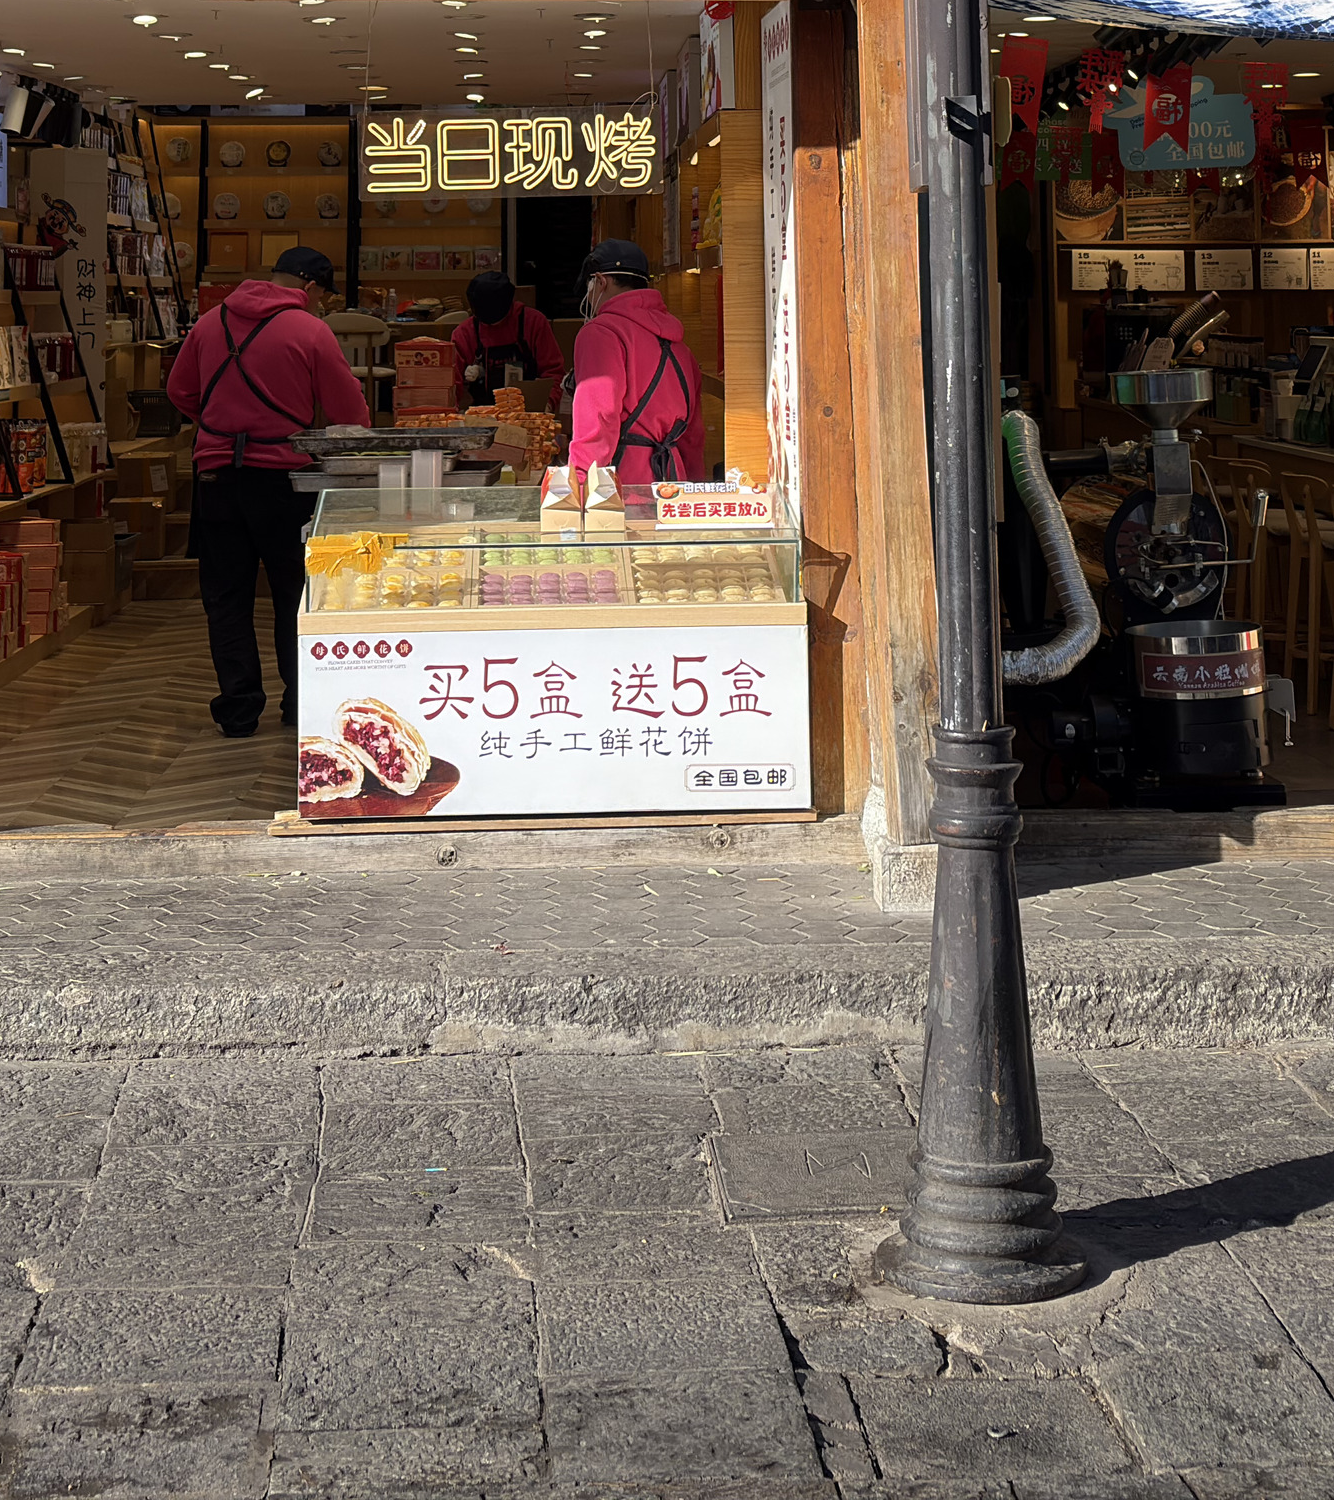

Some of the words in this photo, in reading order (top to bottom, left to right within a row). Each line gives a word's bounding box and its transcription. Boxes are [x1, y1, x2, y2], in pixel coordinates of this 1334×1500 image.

[364, 113, 657, 193] 当日现烤
[1166, 141, 1245, 162] 全国包邮
[76, 258, 96, 350] 财神上门
[661, 502, 768, 518] 先尝后买更放心
[314, 643, 410, 657] 母氏鲜花饼
[1152, 660, 1261, 682] 云南小粒咖啡
[418, 656, 583, 722] 买5盒
[611, 655, 773, 721] 送5盒
[478, 726, 714, 759] 纯手工鲜花饼
[693, 768, 790, 788] 全国包邮
